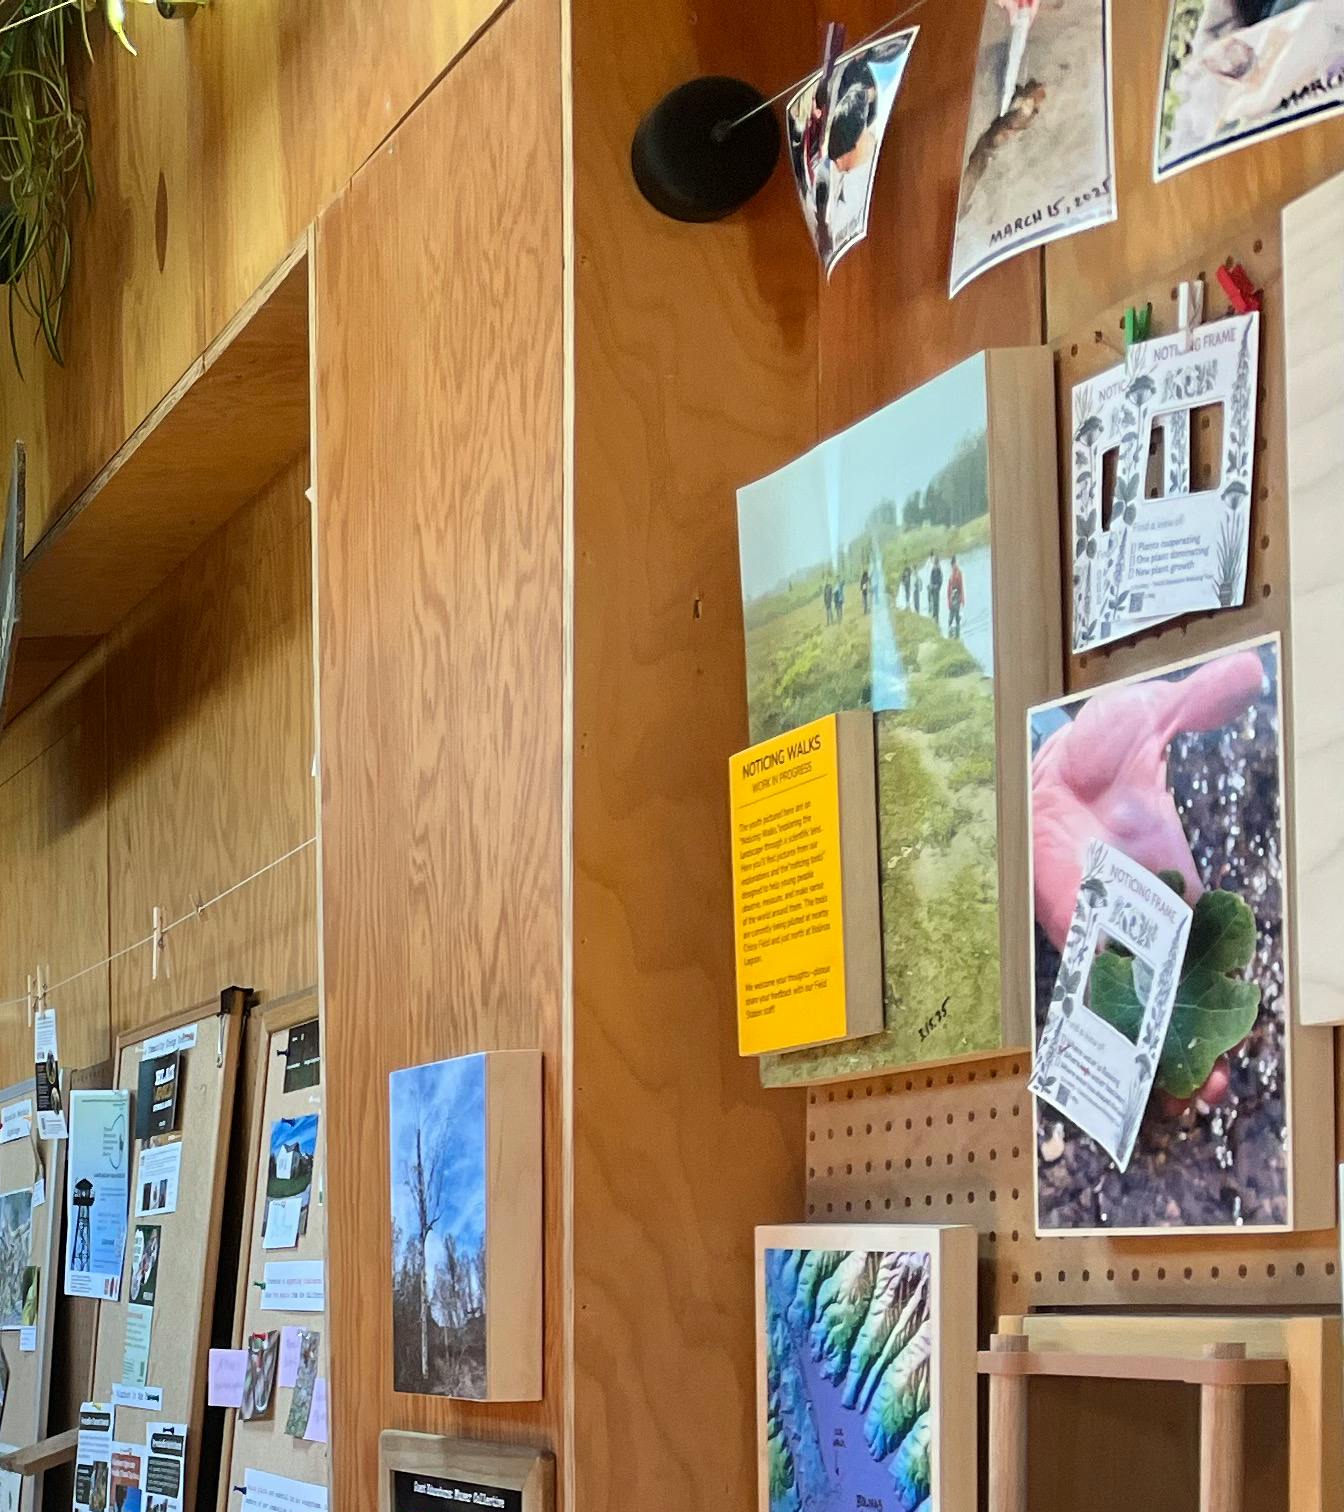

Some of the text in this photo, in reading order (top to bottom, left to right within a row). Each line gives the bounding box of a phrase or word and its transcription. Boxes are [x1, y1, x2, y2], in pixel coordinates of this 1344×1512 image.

[989, 208, 1043, 247] MARCH
[1154, 328, 1237, 361] NOTIG FRAME
[1099, 381, 1127, 401] NOTIC
[1135, 561, 1194, 576] New plant growth
[1151, 551, 1169, 563] plant
[743, 735, 821, 779] NOTICING WALKS
[752, 777, 770, 793] WORK
[778, 761, 812, 783] PROGRESS
[1112, 864, 1152, 902] NOTICING
